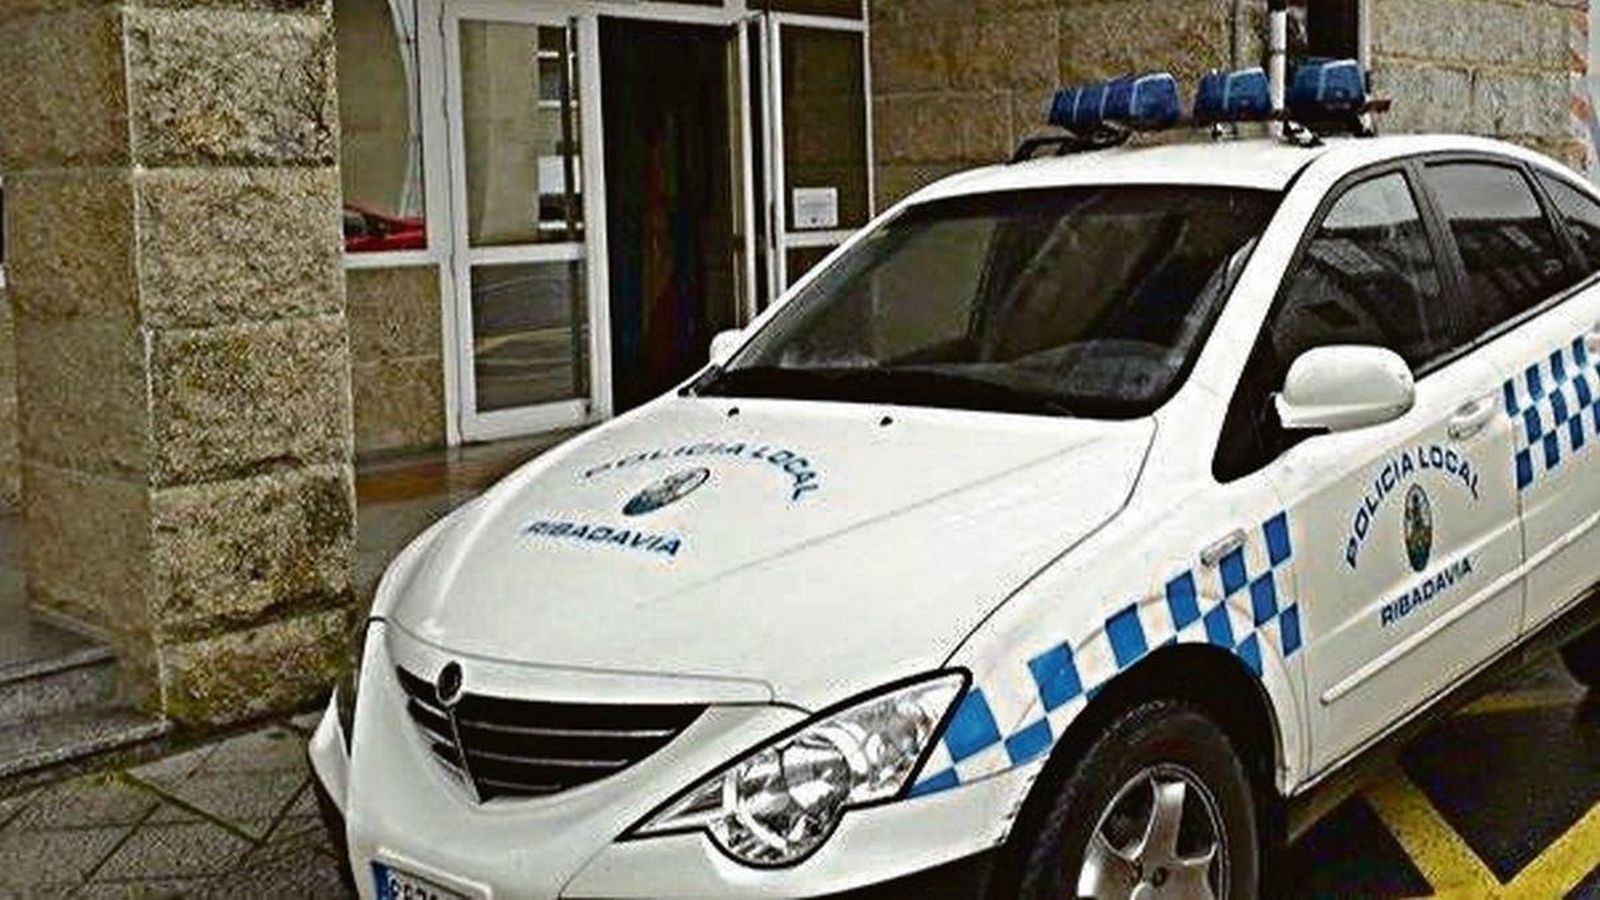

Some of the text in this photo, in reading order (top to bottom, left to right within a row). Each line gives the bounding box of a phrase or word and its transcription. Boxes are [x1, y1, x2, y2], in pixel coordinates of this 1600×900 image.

[752, 445, 819, 501] LOCAL
[525, 520, 681, 556] RIBADAVIA
[1346, 445, 1479, 569] POLICIA LOCAL
[1380, 557, 1473, 627] RIBADAVIA
